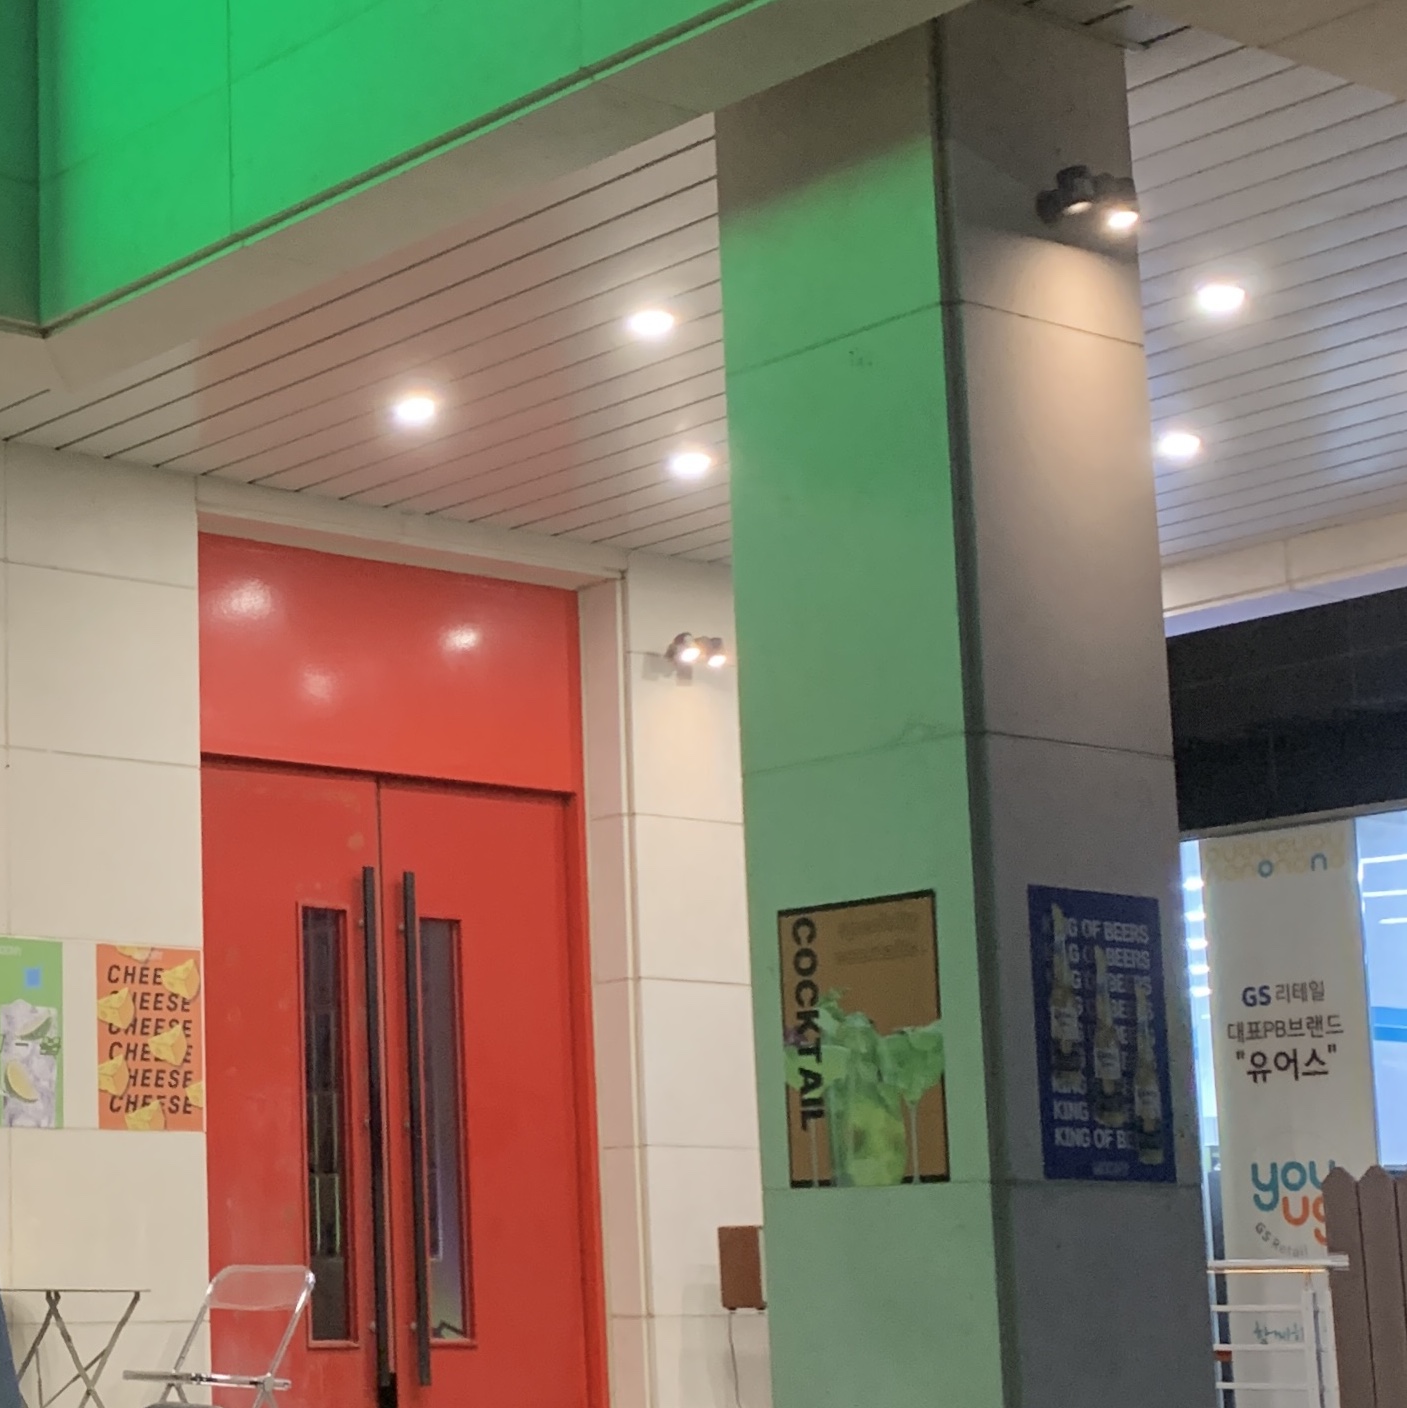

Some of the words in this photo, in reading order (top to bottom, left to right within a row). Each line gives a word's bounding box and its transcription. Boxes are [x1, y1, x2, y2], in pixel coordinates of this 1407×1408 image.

[108, 964, 164, 985] CHEE
[1242, 985, 1272, 1007] GS
[1275, 980, 1325, 1004] 리테일
[791, 917, 824, 1131] COCKTAIL
[1227, 1014, 1344, 1044] 대표PB브랜드
